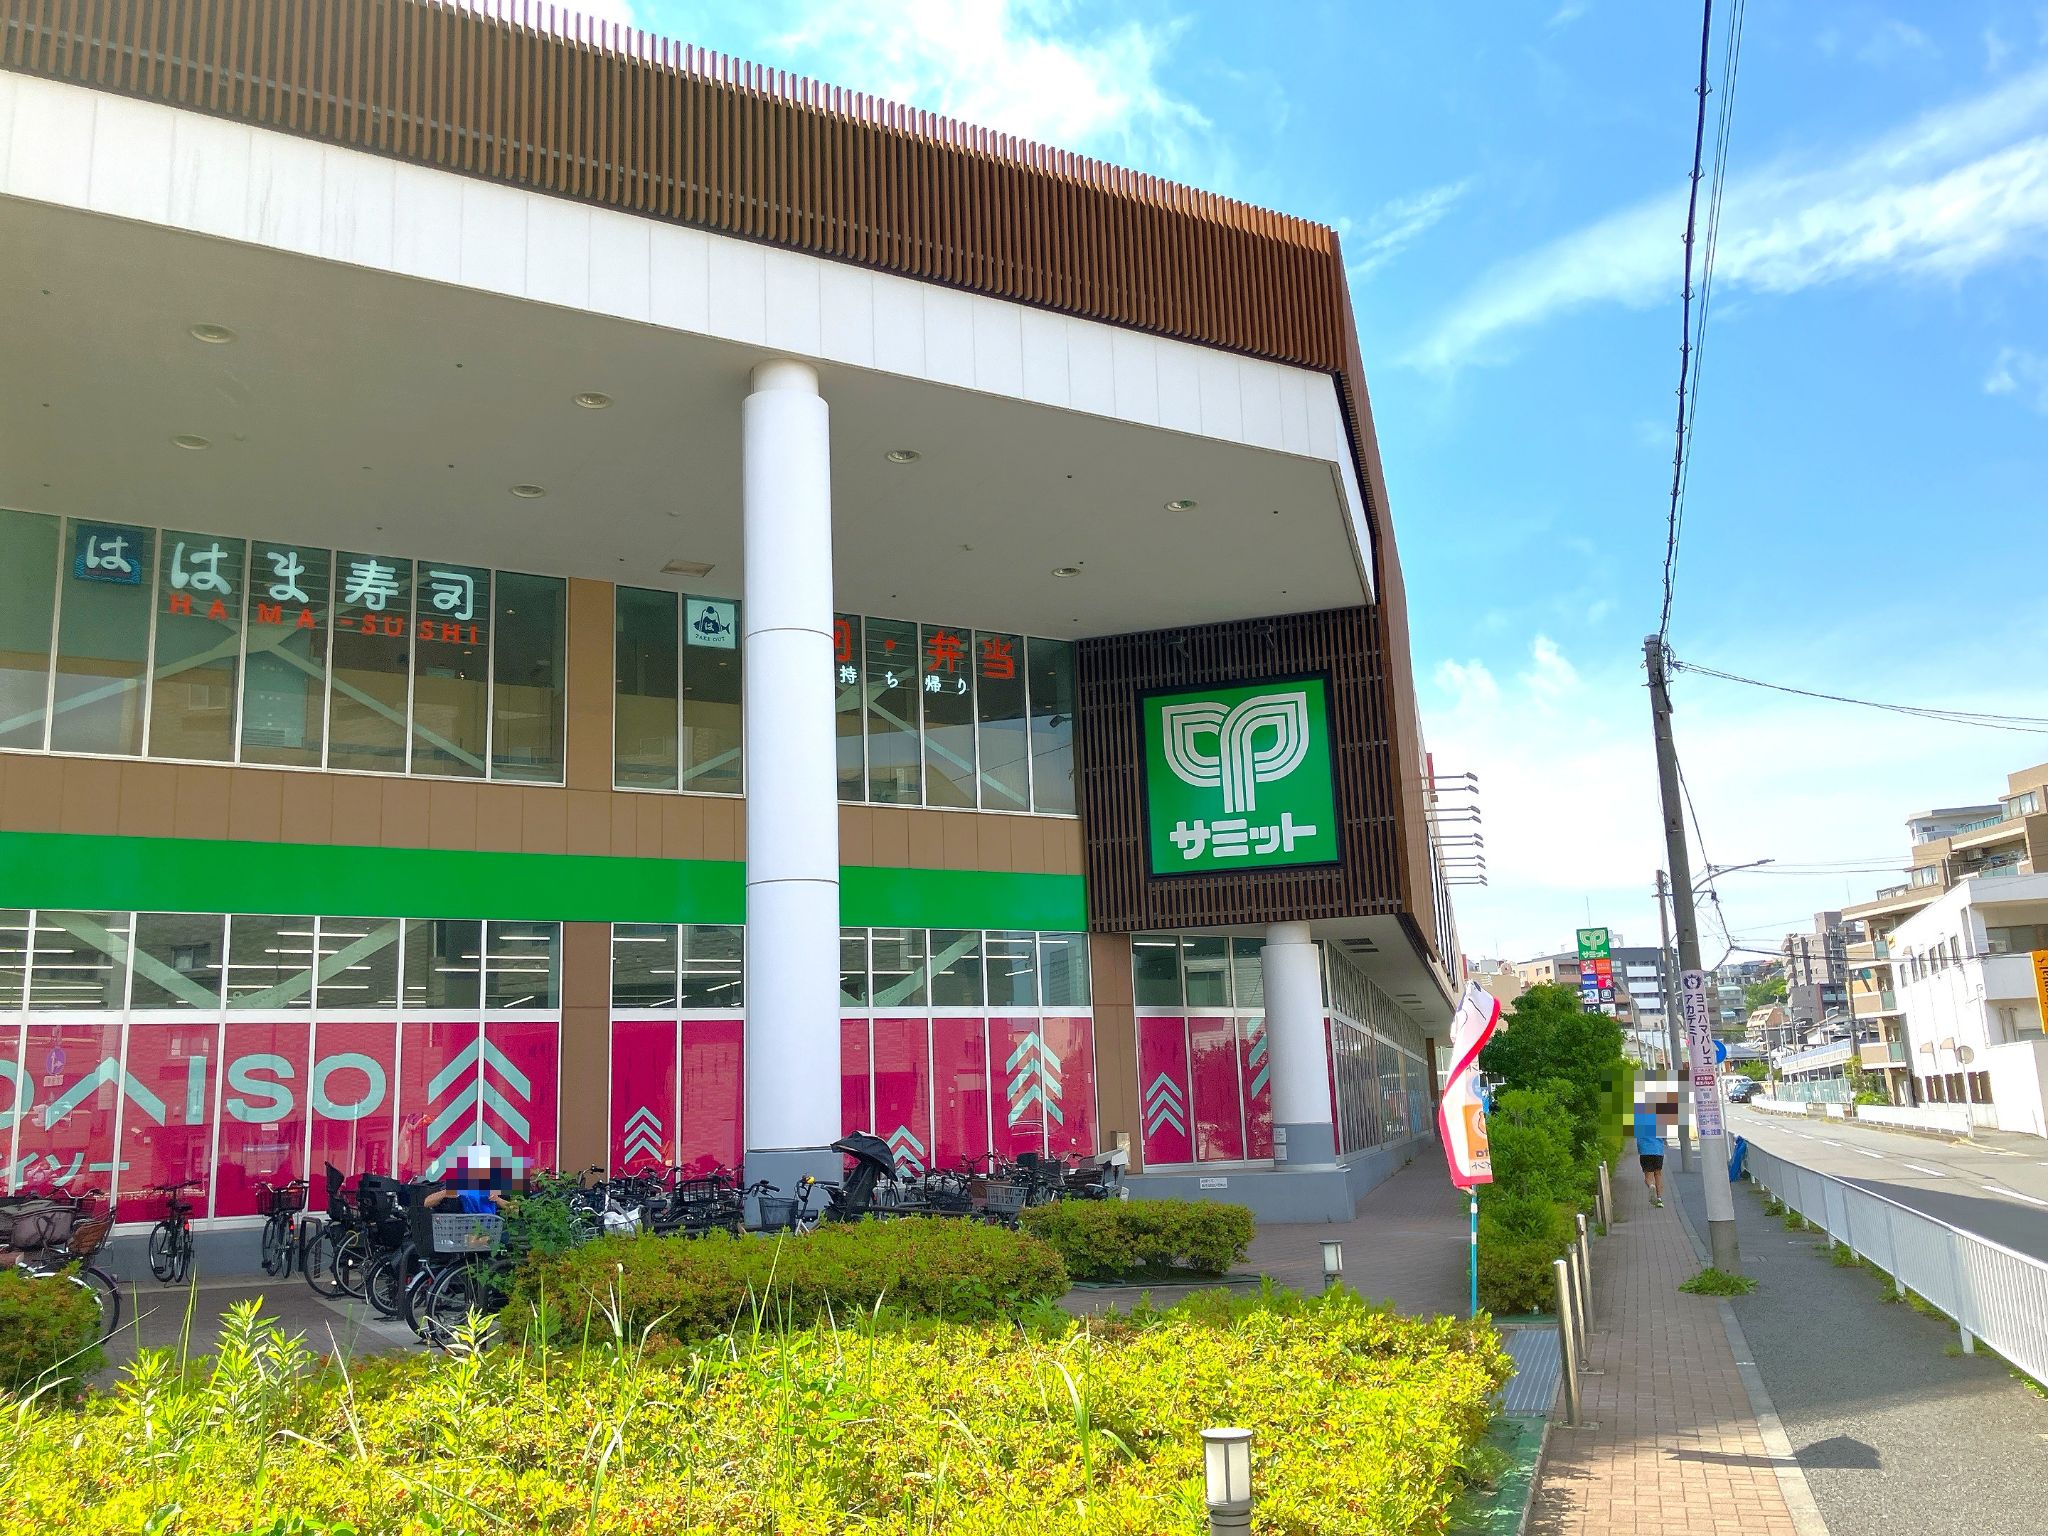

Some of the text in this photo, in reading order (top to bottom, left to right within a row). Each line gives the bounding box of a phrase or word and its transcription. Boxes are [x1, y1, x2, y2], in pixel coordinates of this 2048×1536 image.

[86, 535, 132, 573] は
[170, 541, 475, 621] はま寿司
[839, 664, 967, 695] 持ち帰り
[1169, 812, 1317, 860] サミット
[1581, 949, 1608, 959] サミット
[1684, 994, 1697, 1046] アカデミー
[1695, 993, 1713, 1065] ヨコハマバレエ
